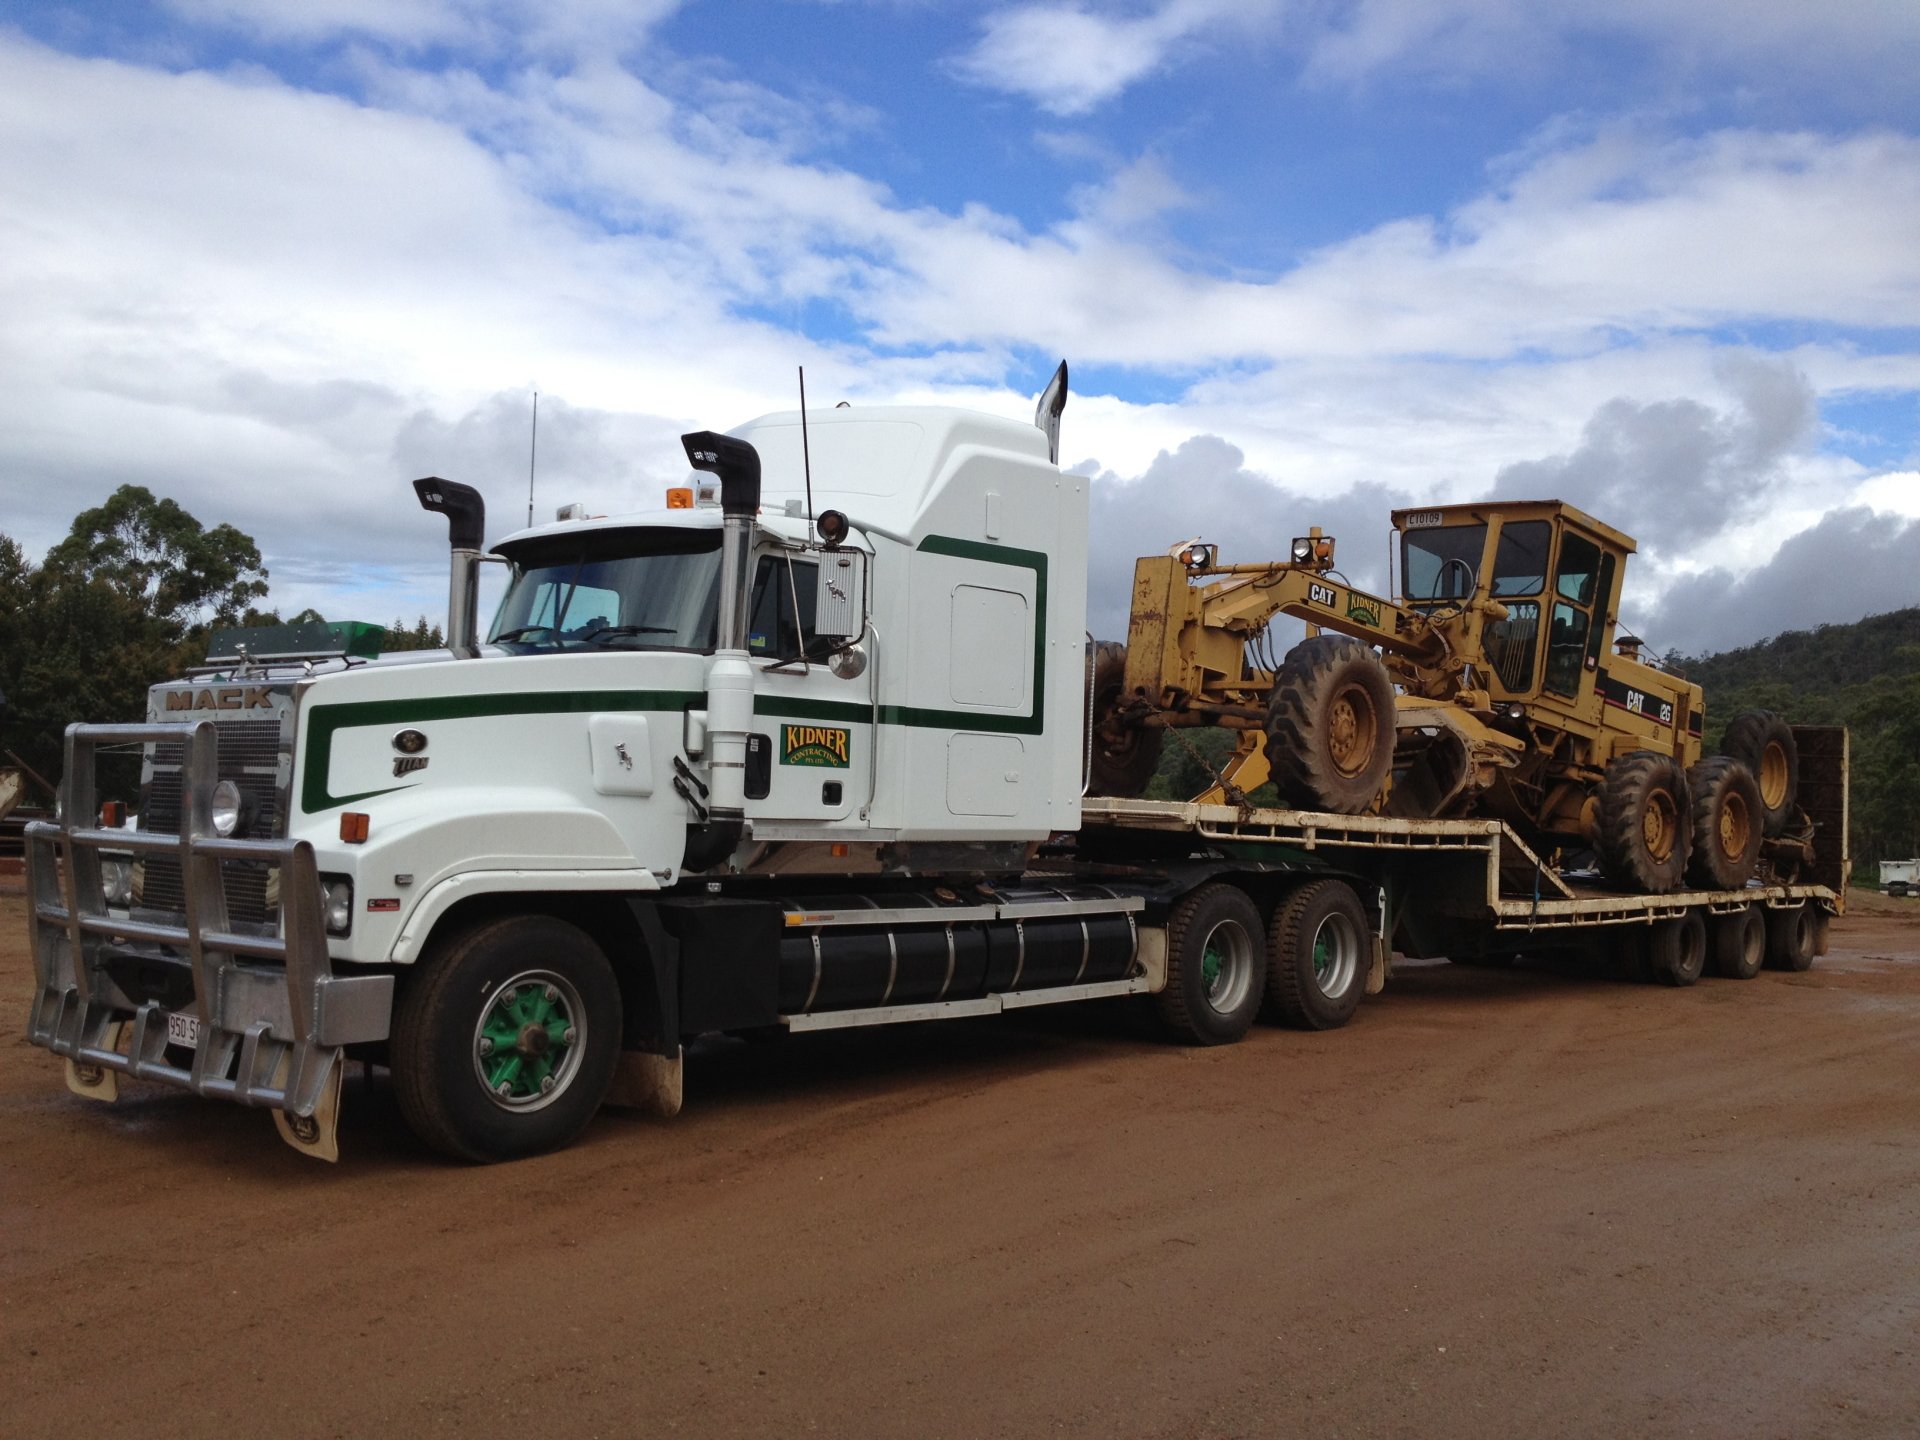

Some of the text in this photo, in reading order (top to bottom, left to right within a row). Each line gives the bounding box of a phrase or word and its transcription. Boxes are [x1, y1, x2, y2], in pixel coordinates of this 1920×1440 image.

[1311, 584, 1334, 606] CAT
[1350, 594, 1380, 623] KIDNER
[166, 687, 274, 711] MACK
[1627, 690, 1645, 714] CAT
[787, 726, 848, 762] KIDNER
[790, 748, 838, 767] CONTRACTING
